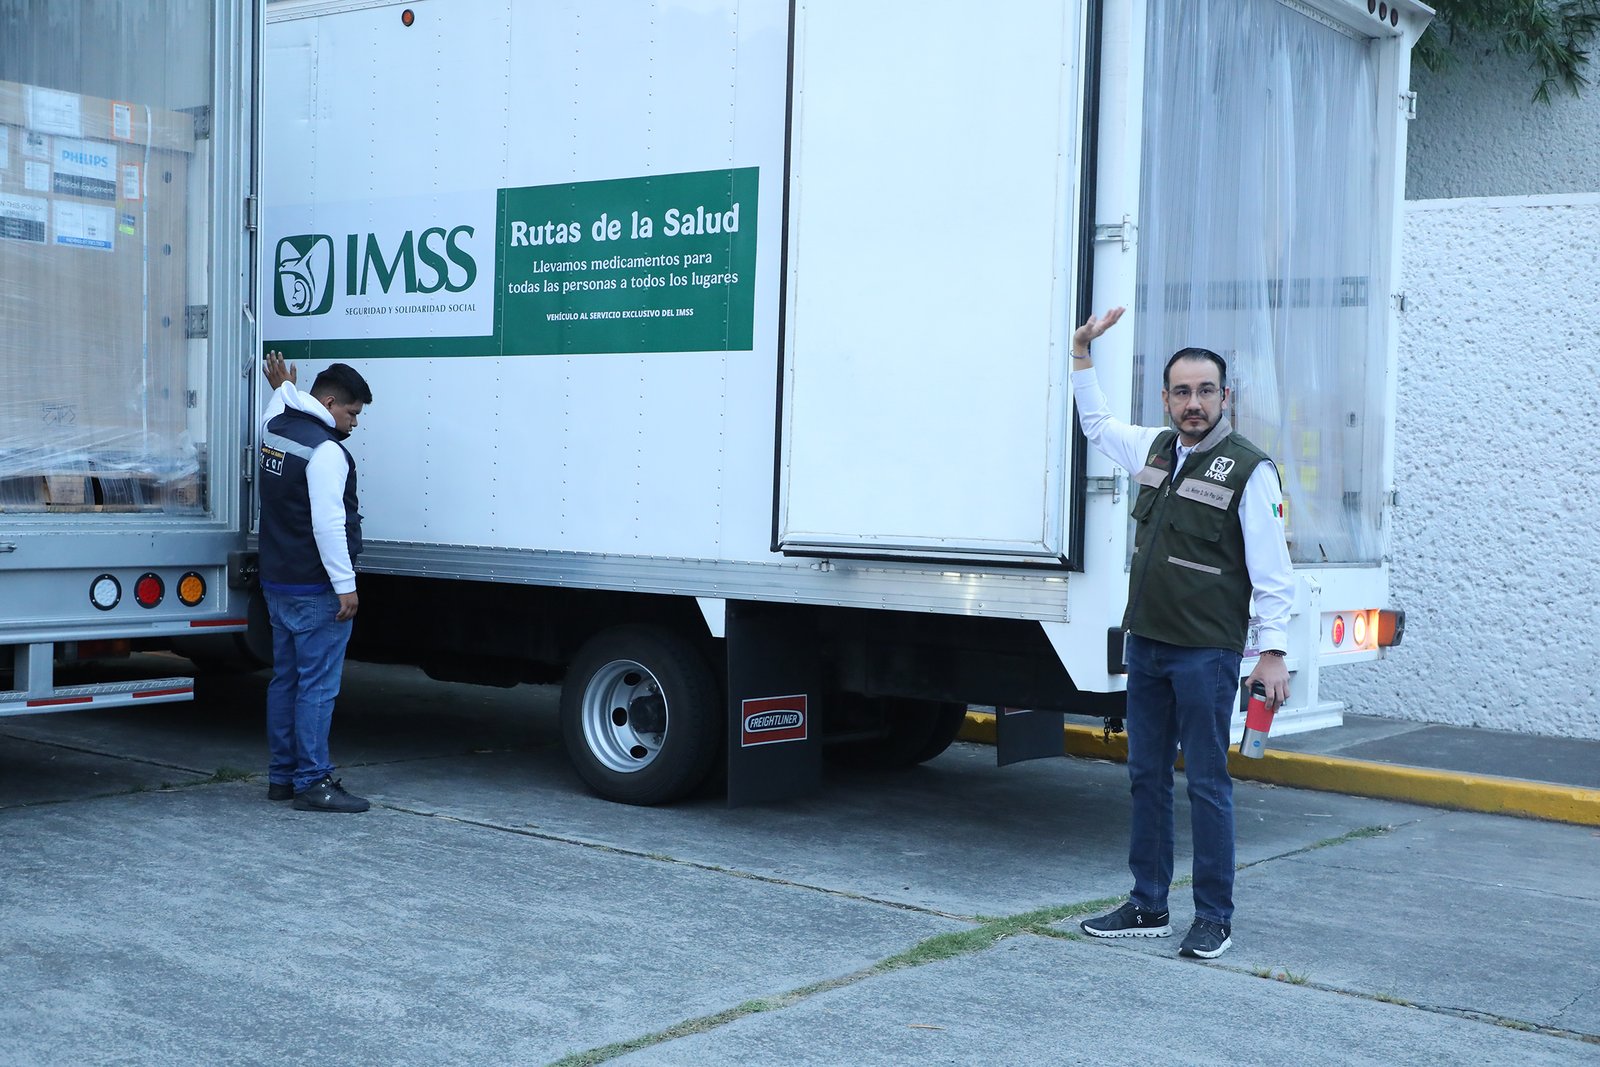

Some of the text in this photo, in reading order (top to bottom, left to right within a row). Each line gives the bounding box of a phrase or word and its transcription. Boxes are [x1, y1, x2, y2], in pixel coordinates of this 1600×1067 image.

[62, 150, 108, 167] PHILIPS
[55, 177, 115, 195] Medical Equipment
[510, 202, 740, 247] Rutas de la Salud
[346, 224, 478, 296] IMSS
[533, 252, 712, 273] Llevamos medicamentos para
[508, 271, 739, 295] todas las personas a todos los lugares
[345, 303, 477, 316] SEGURIDAD Y SOLIDARIDAD SOCIAL
[546, 308, 694, 321] VEHÍCULO AL SERVICIO EXCLUSIVO DEL IMSS
[1205, 469, 1228, 482] IMSS
[749, 714, 798, 729] FREIGHTLINER
